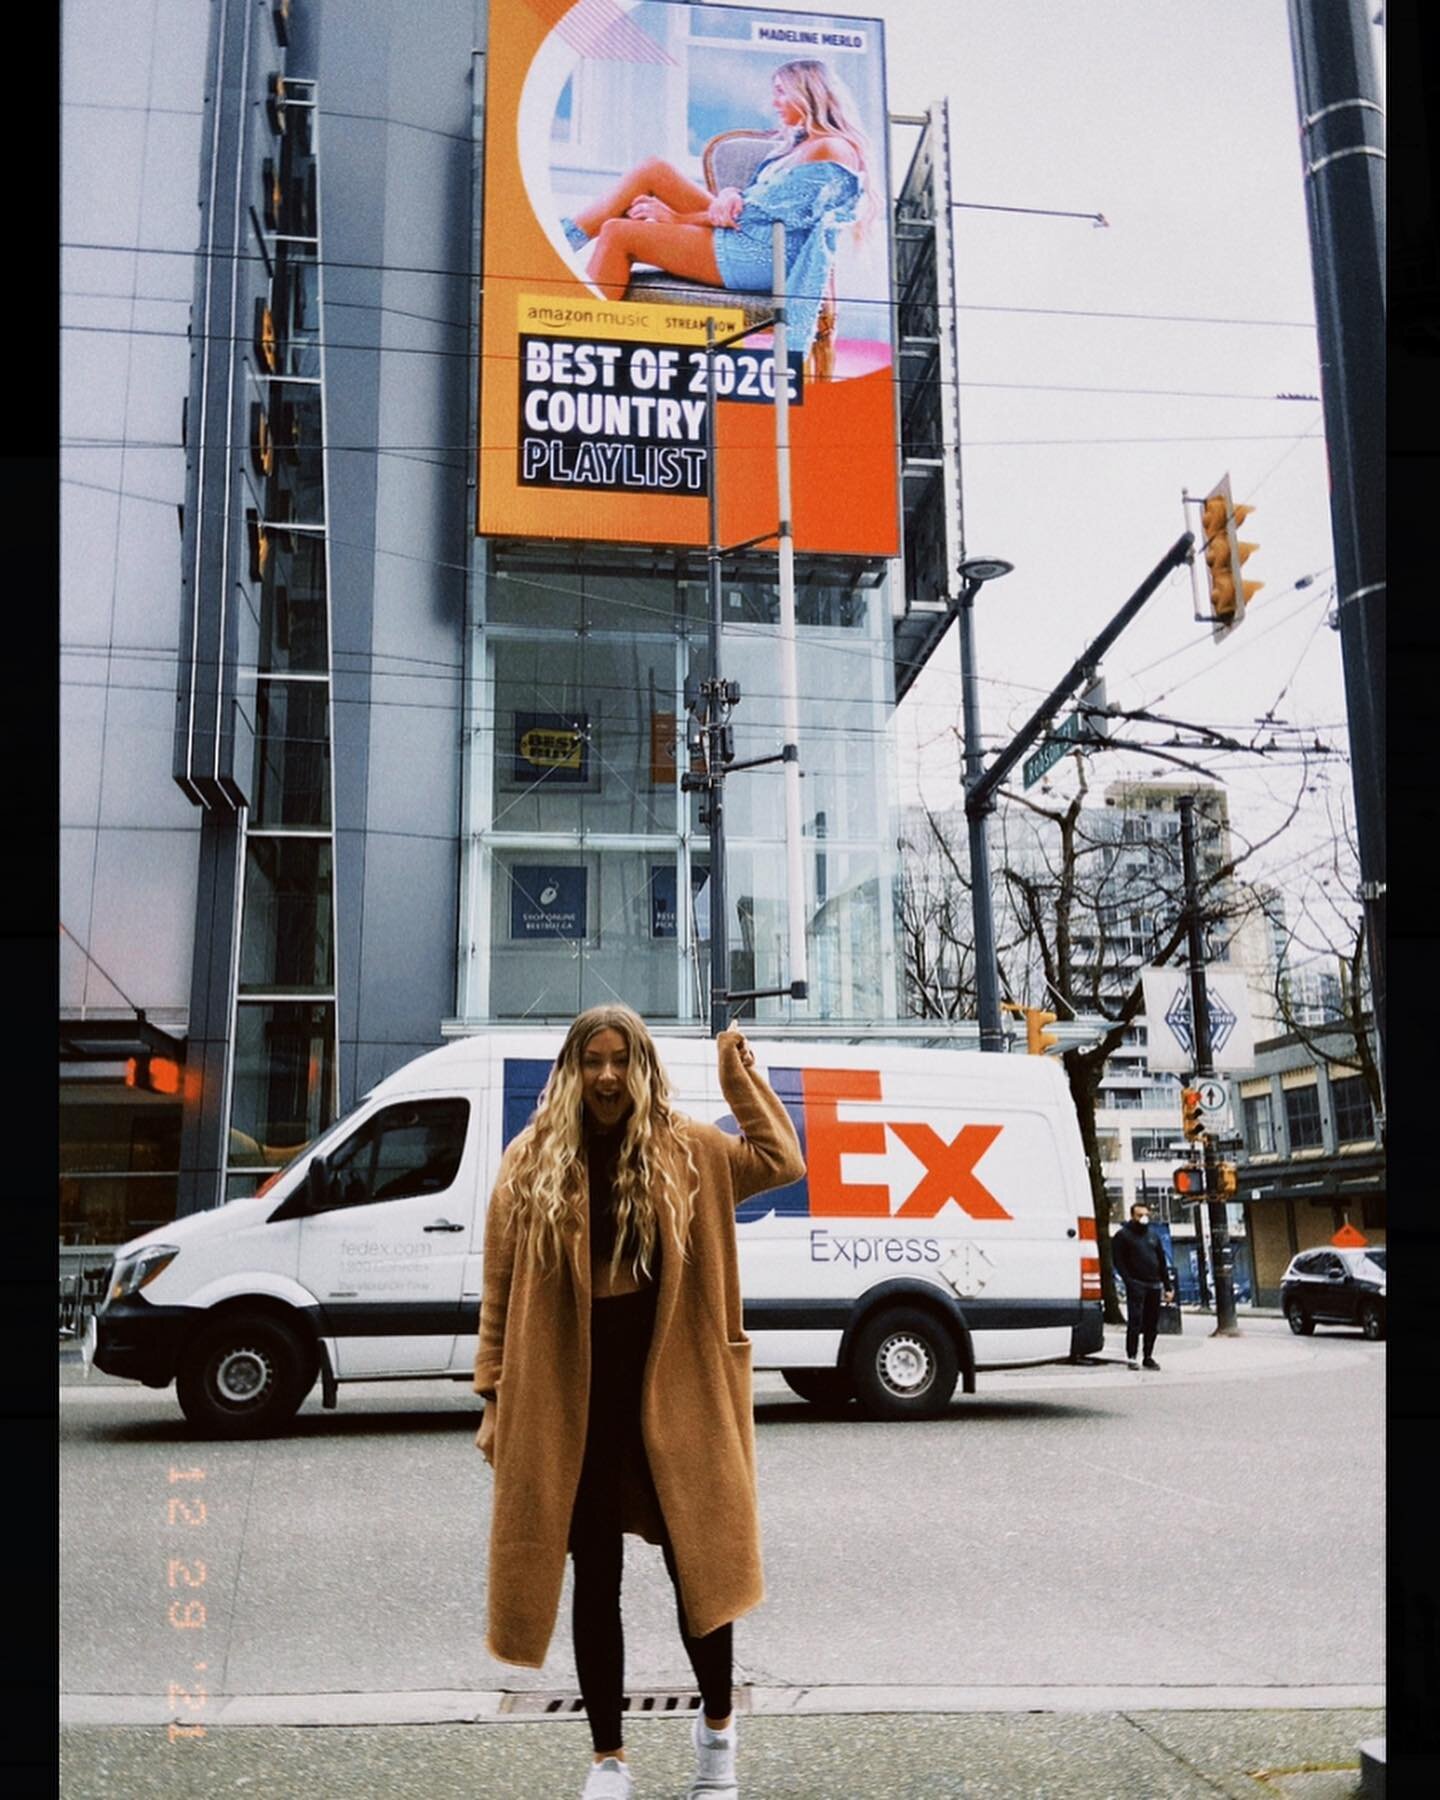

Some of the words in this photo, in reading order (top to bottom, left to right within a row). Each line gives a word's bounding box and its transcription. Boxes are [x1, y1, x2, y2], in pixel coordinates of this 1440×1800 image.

[759, 28, 818, 44] MADELINE
[821, 33, 862, 48] MERLO
[527, 306, 593, 323] amazon
[596, 312, 649, 328] music
[526, 341, 621, 387] BEST
[630, 348, 680, 391] OF
[525, 389, 707, 440] COUNTRY
[523, 437, 707, 488] PLAYLIST
[528, 734, 581, 748] BEST
[529, 747, 574, 760] BUY
[340, 1239, 432, 1257] fedex.com
[810, 1229, 941, 1269] Express
